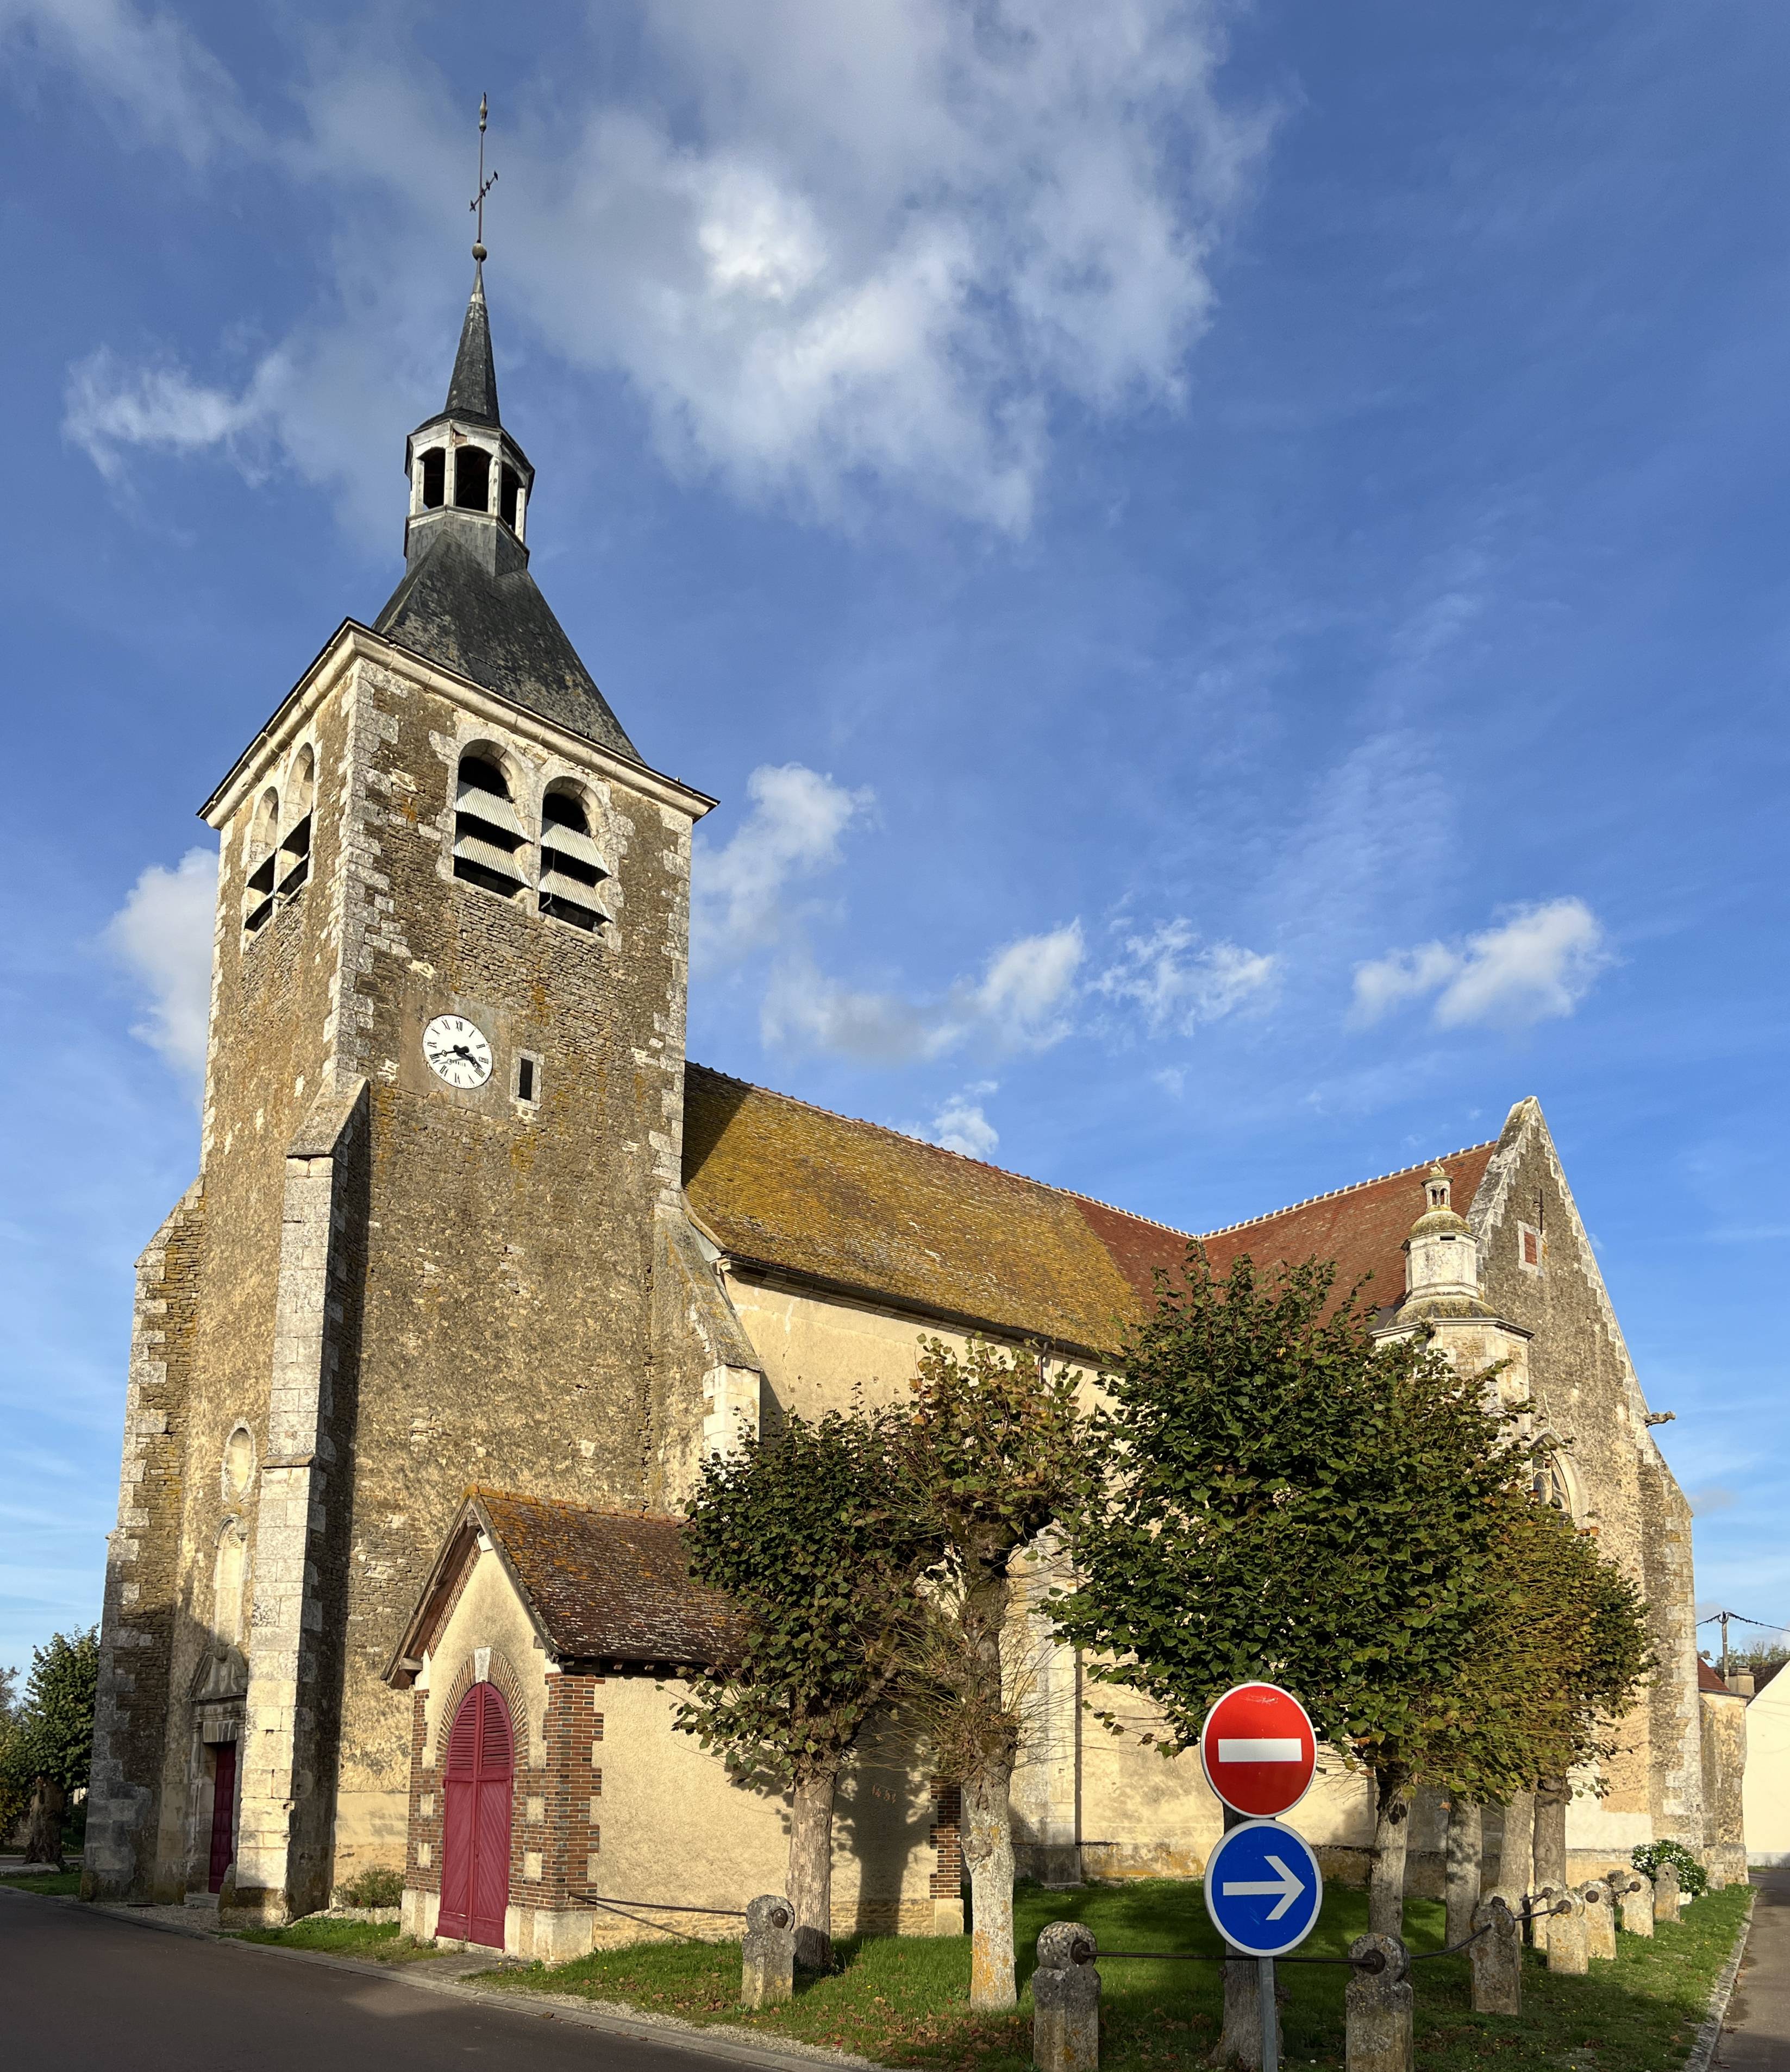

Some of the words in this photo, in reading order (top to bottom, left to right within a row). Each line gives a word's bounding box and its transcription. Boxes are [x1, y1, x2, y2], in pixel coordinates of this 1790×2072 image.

[427, 1040, 437, 1048] IX
[439, 1065, 449, 1077] VII
[454, 1072, 461, 1084] VI
